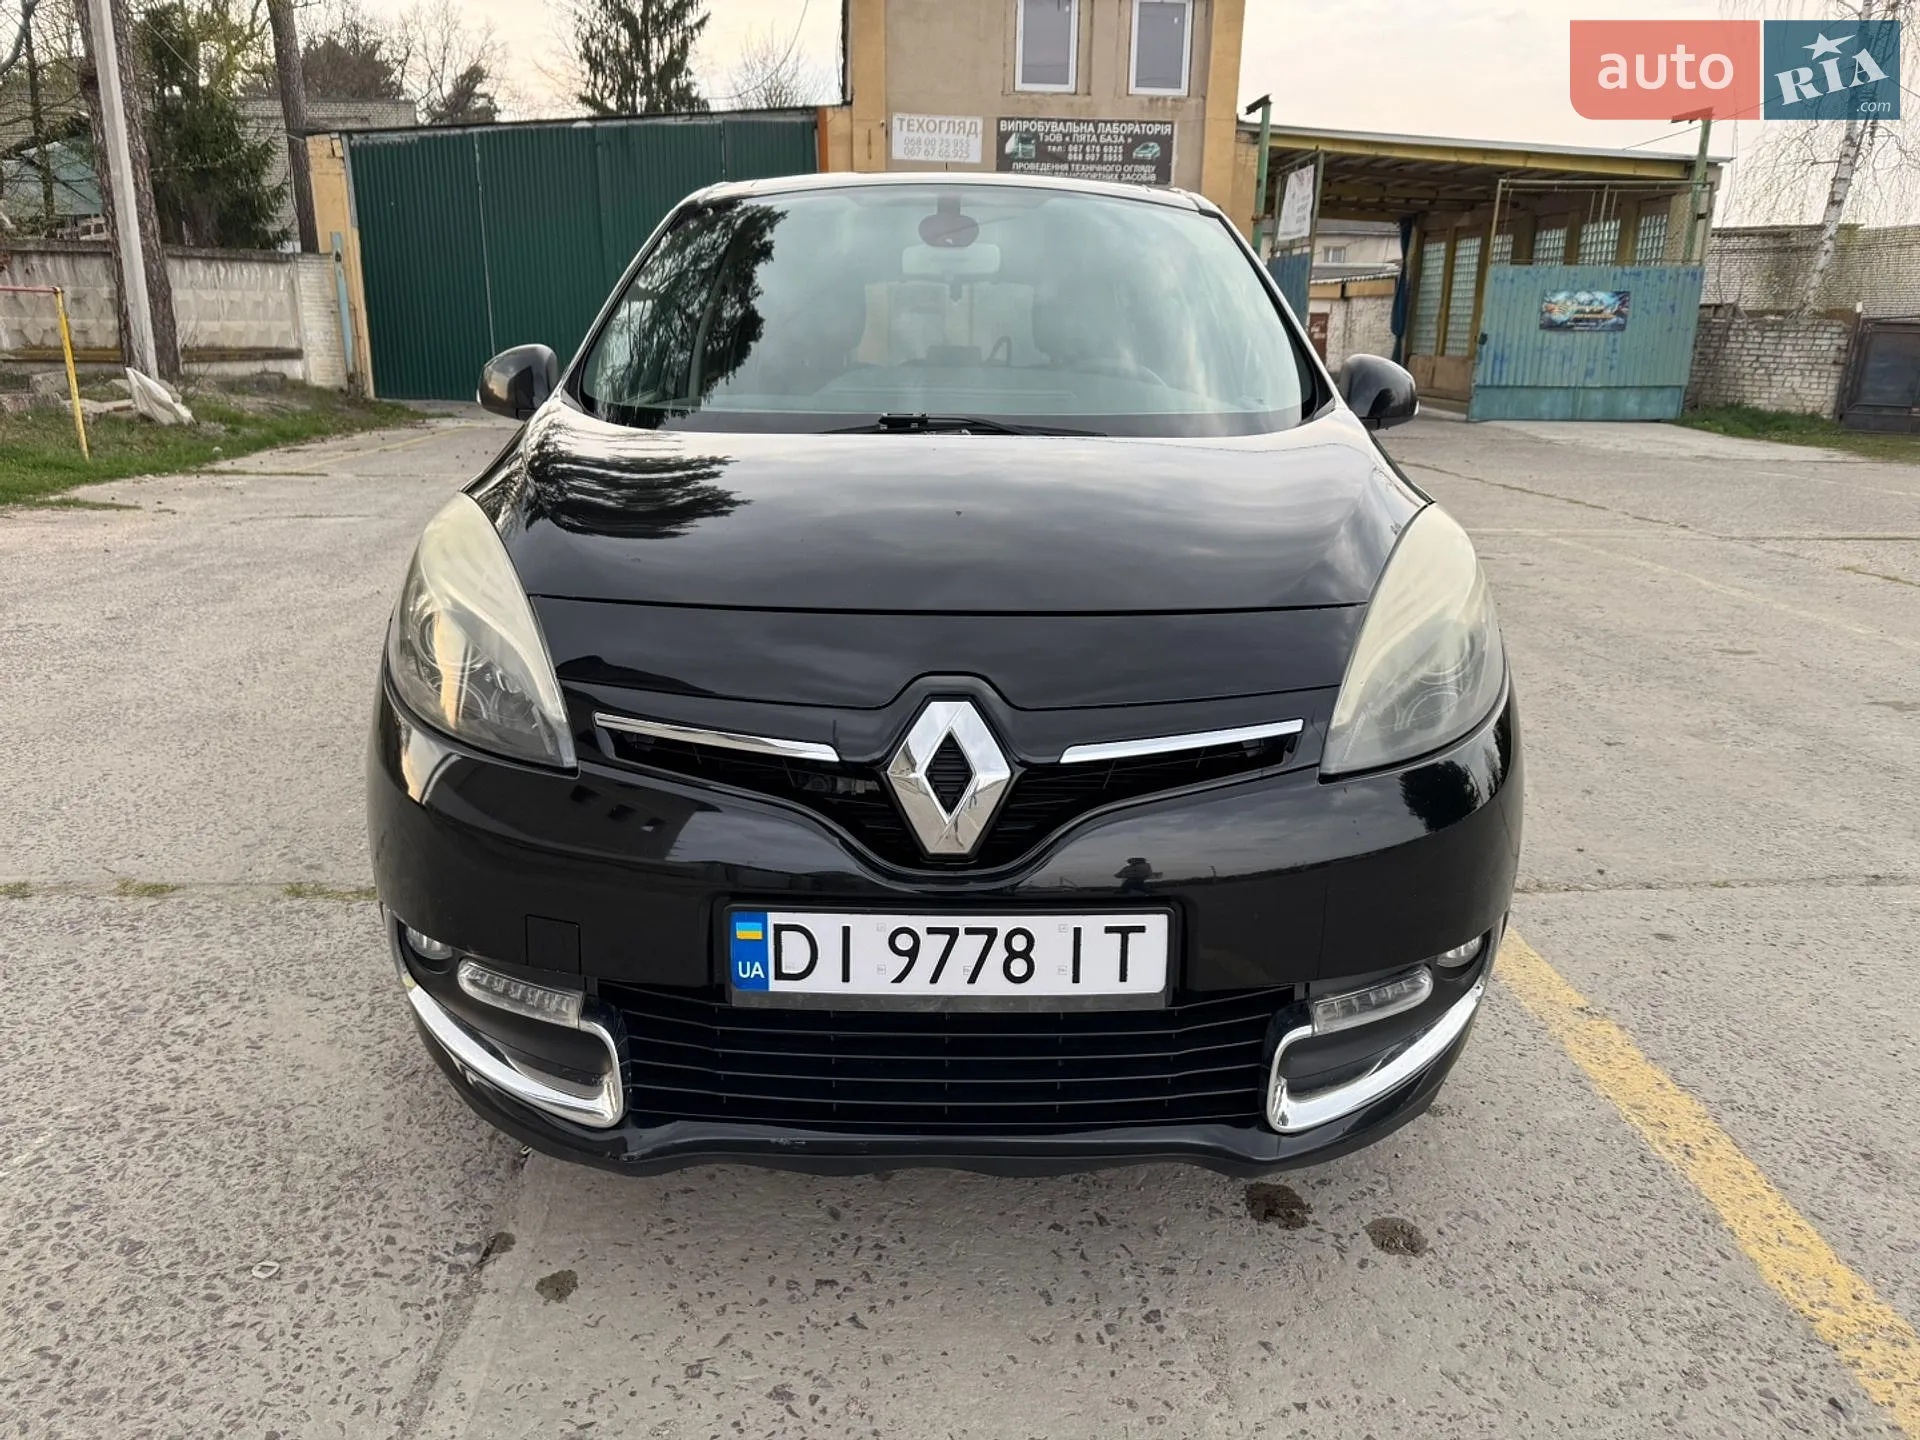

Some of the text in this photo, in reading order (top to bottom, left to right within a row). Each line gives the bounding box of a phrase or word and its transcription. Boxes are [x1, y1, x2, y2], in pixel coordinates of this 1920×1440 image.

[896, 117, 978, 138] ТЕХОГЛЯД
[1000, 119, 1172, 135] ВИПРОБУВАЛЬНА ЛАБОРАТОРІЯ
[904, 136, 922, 146] 068
[1099, 135, 1125, 143] БАЗА
[1012, 162, 1156, 173] ПРОВЕДЕННЯ ТЕХНІЧНОГО ОГЛЯДУ
[1121, 173, 1157, 181] ЗАСОБІВ
[773, 923, 1147, 985] DI 9778 IT
[738, 961, 765, 979] UA
